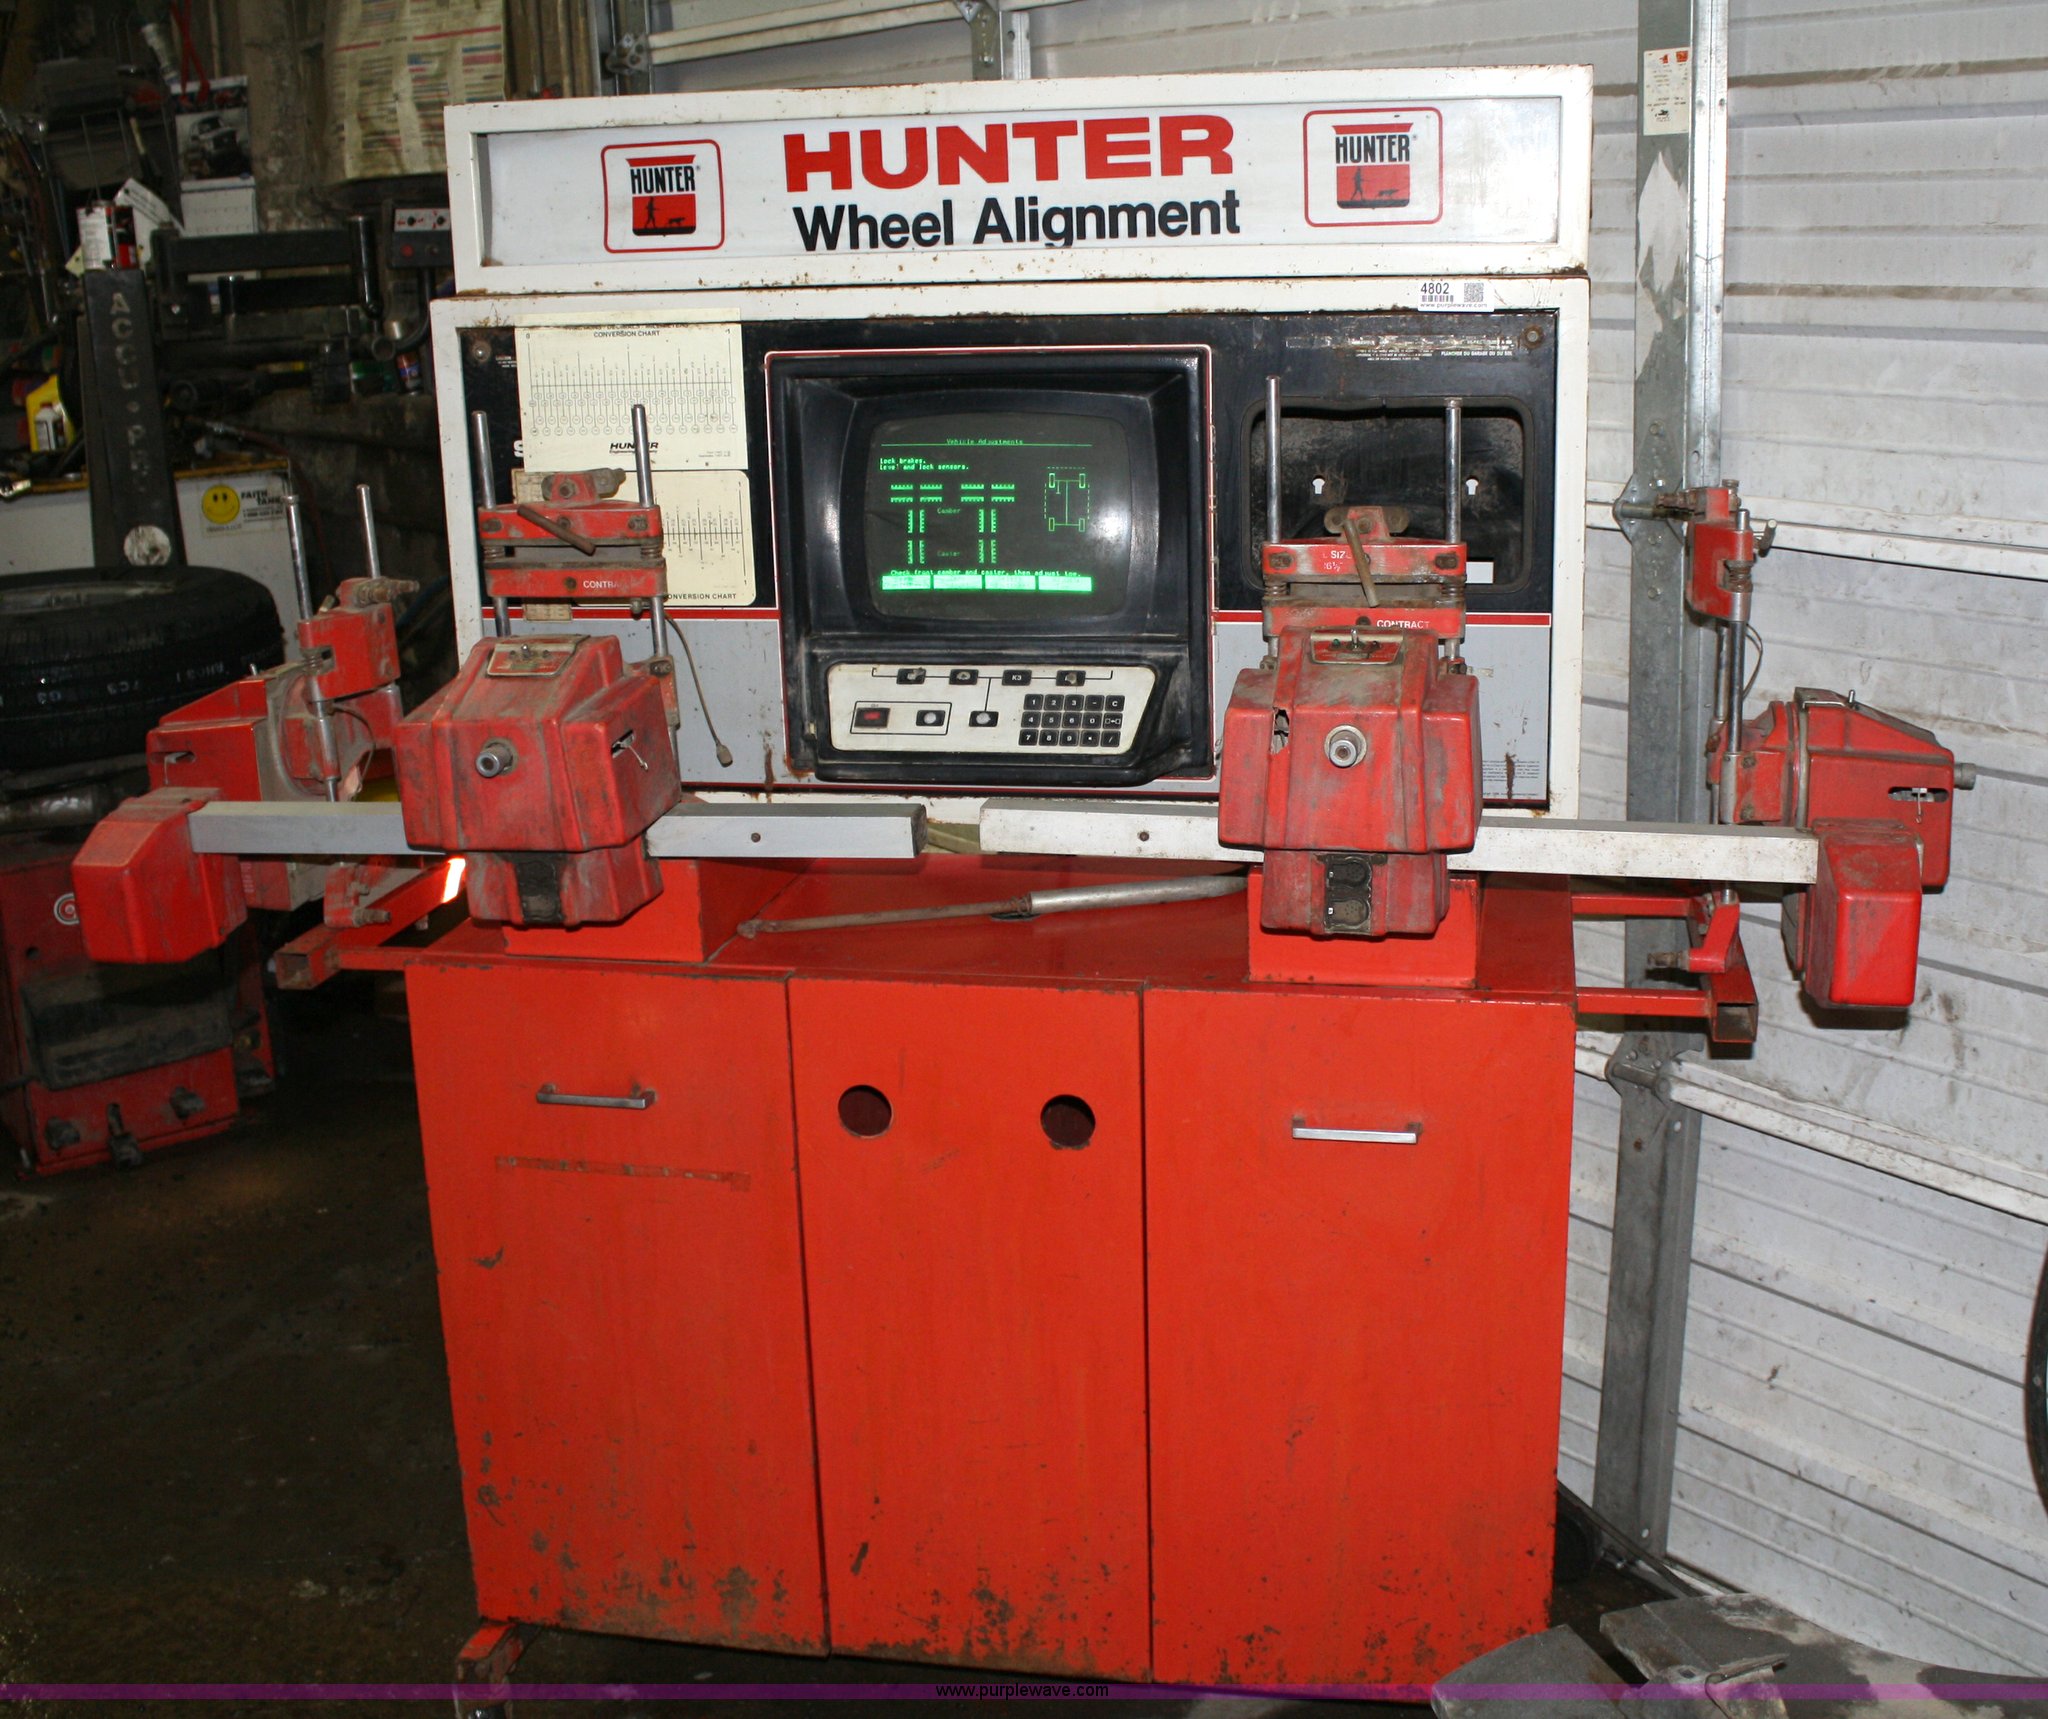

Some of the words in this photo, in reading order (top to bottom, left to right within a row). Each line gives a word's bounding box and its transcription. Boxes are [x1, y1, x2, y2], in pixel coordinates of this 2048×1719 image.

[784, 114, 1235, 193] HUNTER
[1335, 134, 1411, 164] HUNTER
[630, 165, 696, 195] HUNTER
[792, 198, 955, 252] Wheel
[972, 189, 1241, 249] Alignment
[1420, 282, 1450, 295] 4802
[593, 330, 637, 338] CONVERSION
[1376, 619, 1431, 629] CONTRACT
